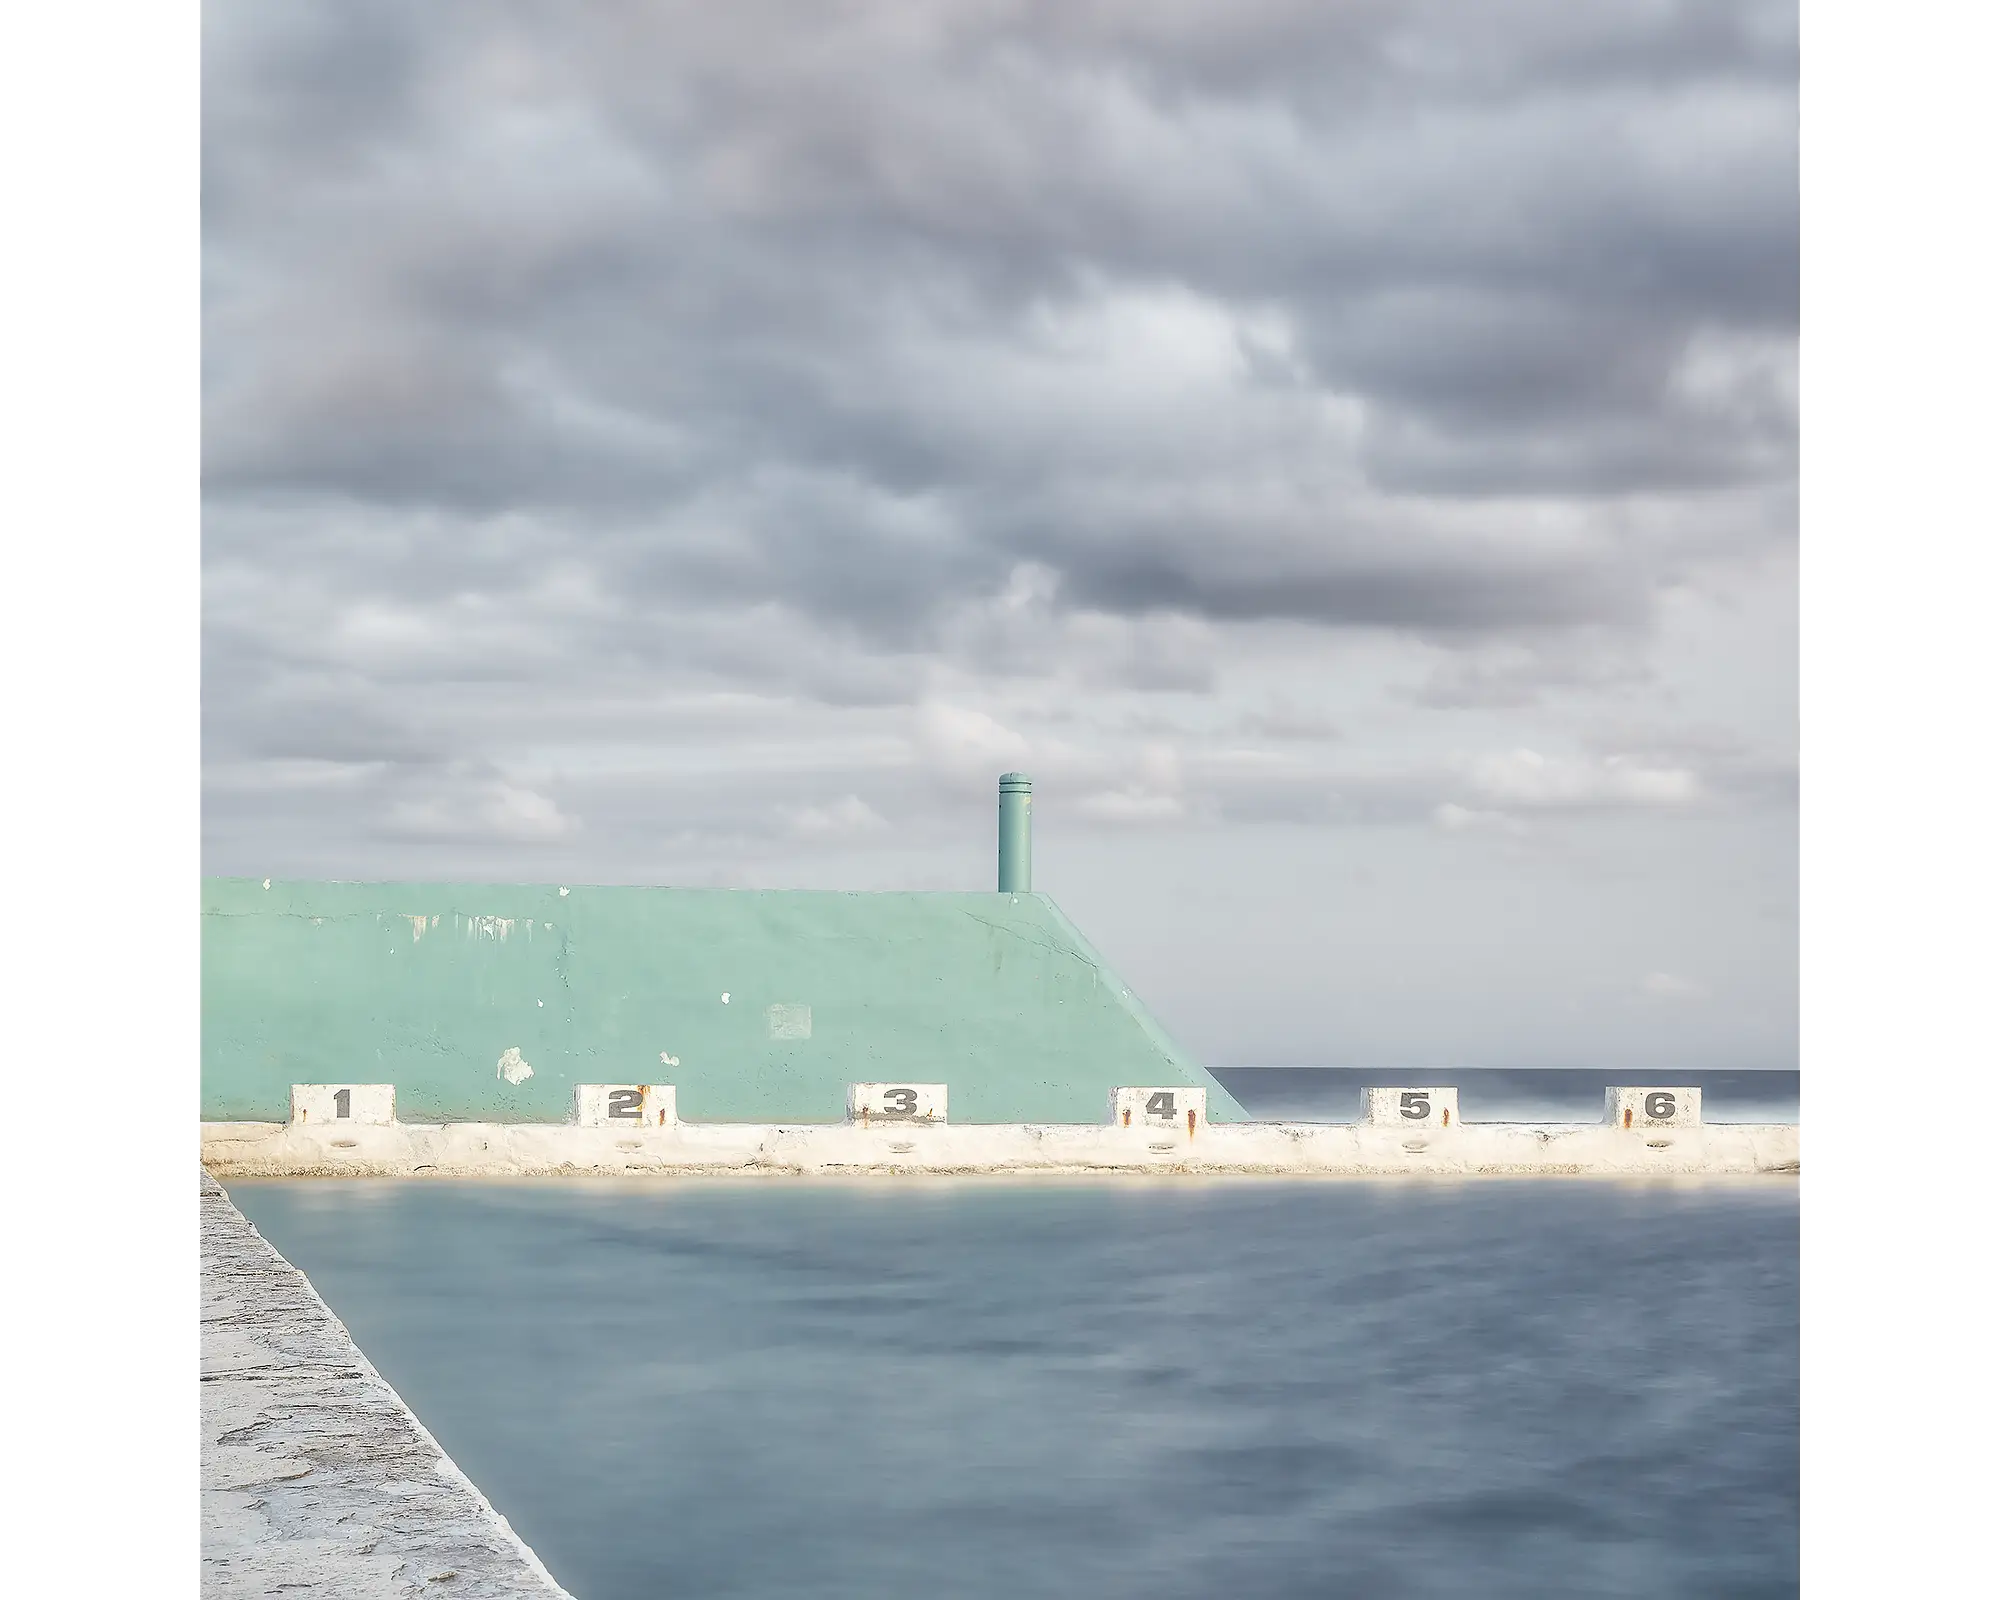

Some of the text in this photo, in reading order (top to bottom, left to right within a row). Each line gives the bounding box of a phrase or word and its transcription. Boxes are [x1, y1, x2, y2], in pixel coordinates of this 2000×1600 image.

[333, 1089, 351, 1119] 1
[608, 1089, 644, 1119] 2
[883, 1088, 918, 1116] 3
[1145, 1091, 1177, 1120] 4
[1399, 1092, 1431, 1120] 5
[1644, 1092, 1676, 1120] 6
